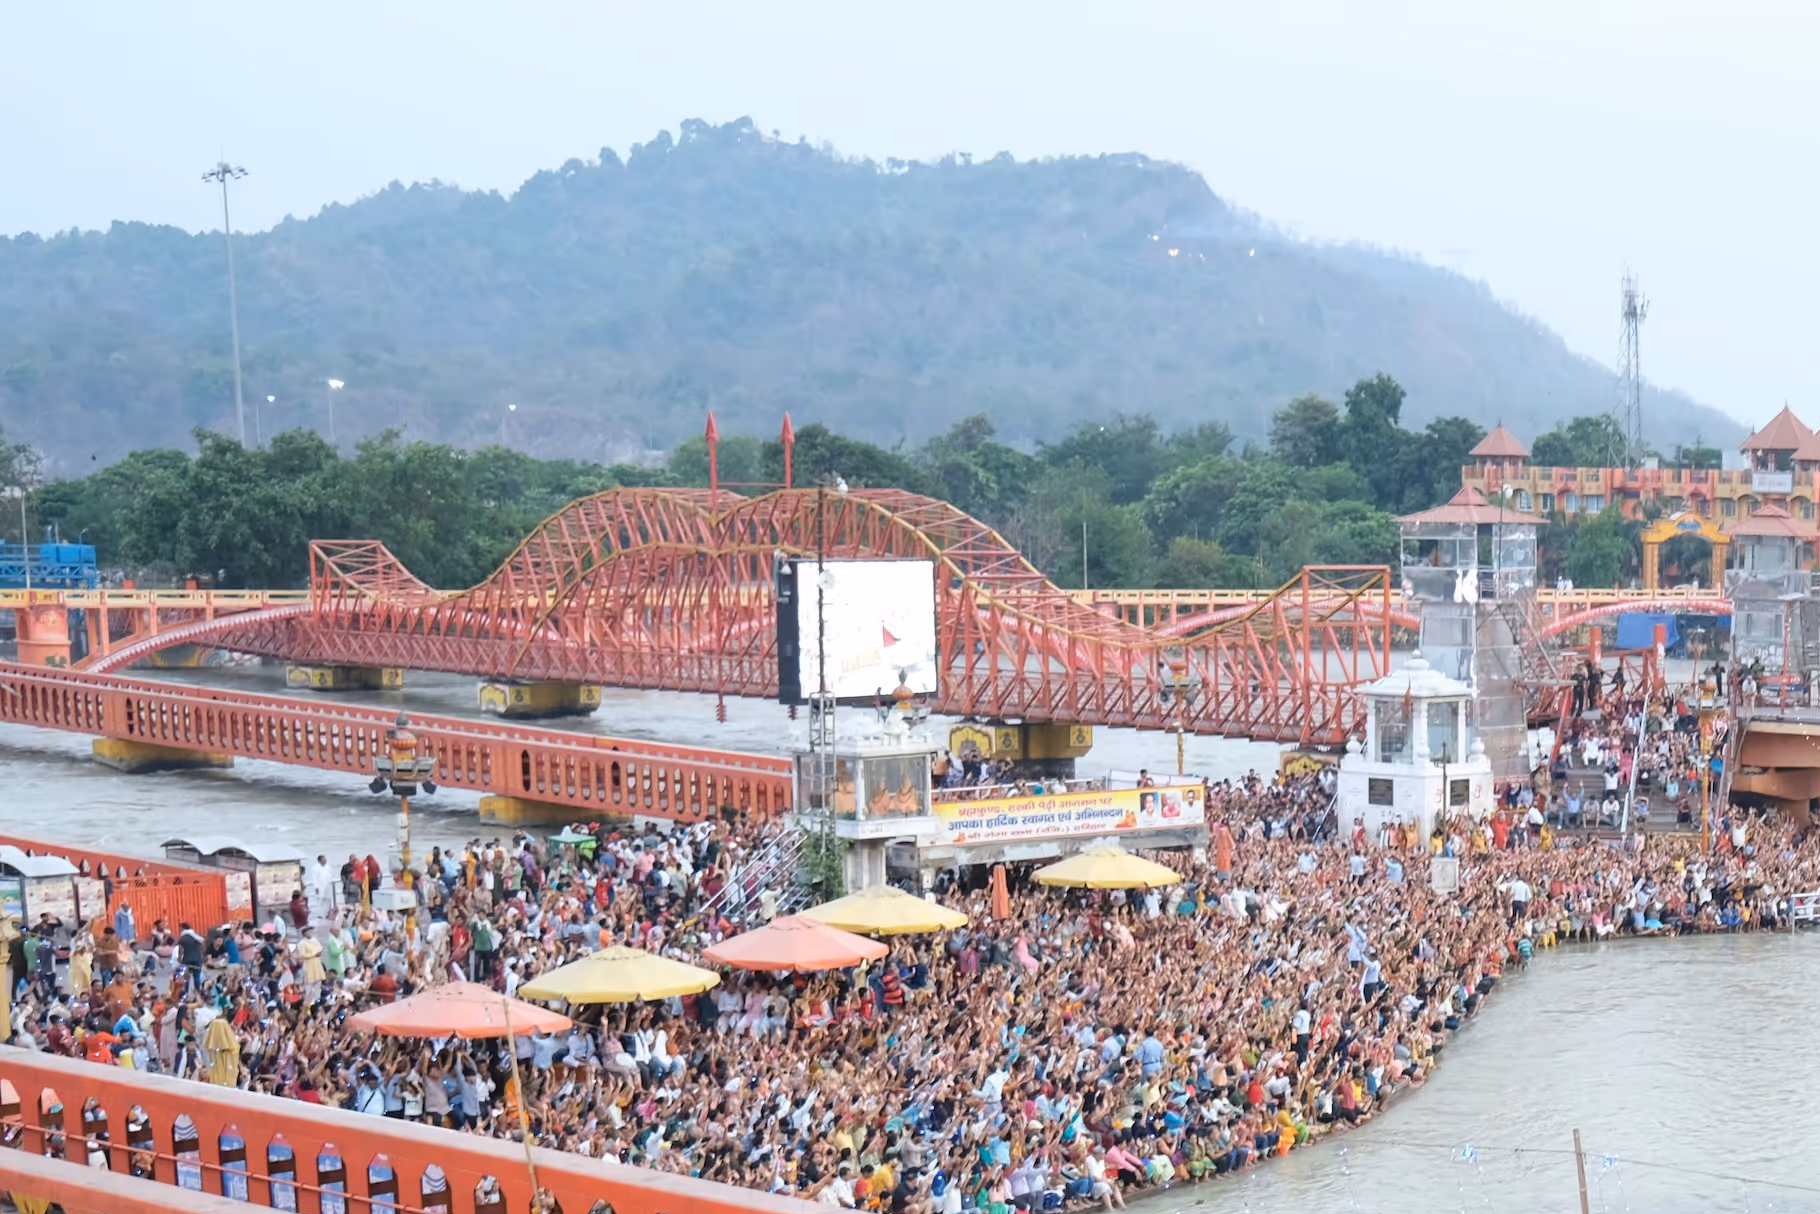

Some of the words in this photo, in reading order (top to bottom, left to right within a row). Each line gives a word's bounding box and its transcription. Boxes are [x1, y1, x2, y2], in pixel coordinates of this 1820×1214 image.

[948, 820, 982, 831] आपका
[986, 813, 1018, 828] हार्दिक
[1021, 814, 1055, 825] स्वागत
